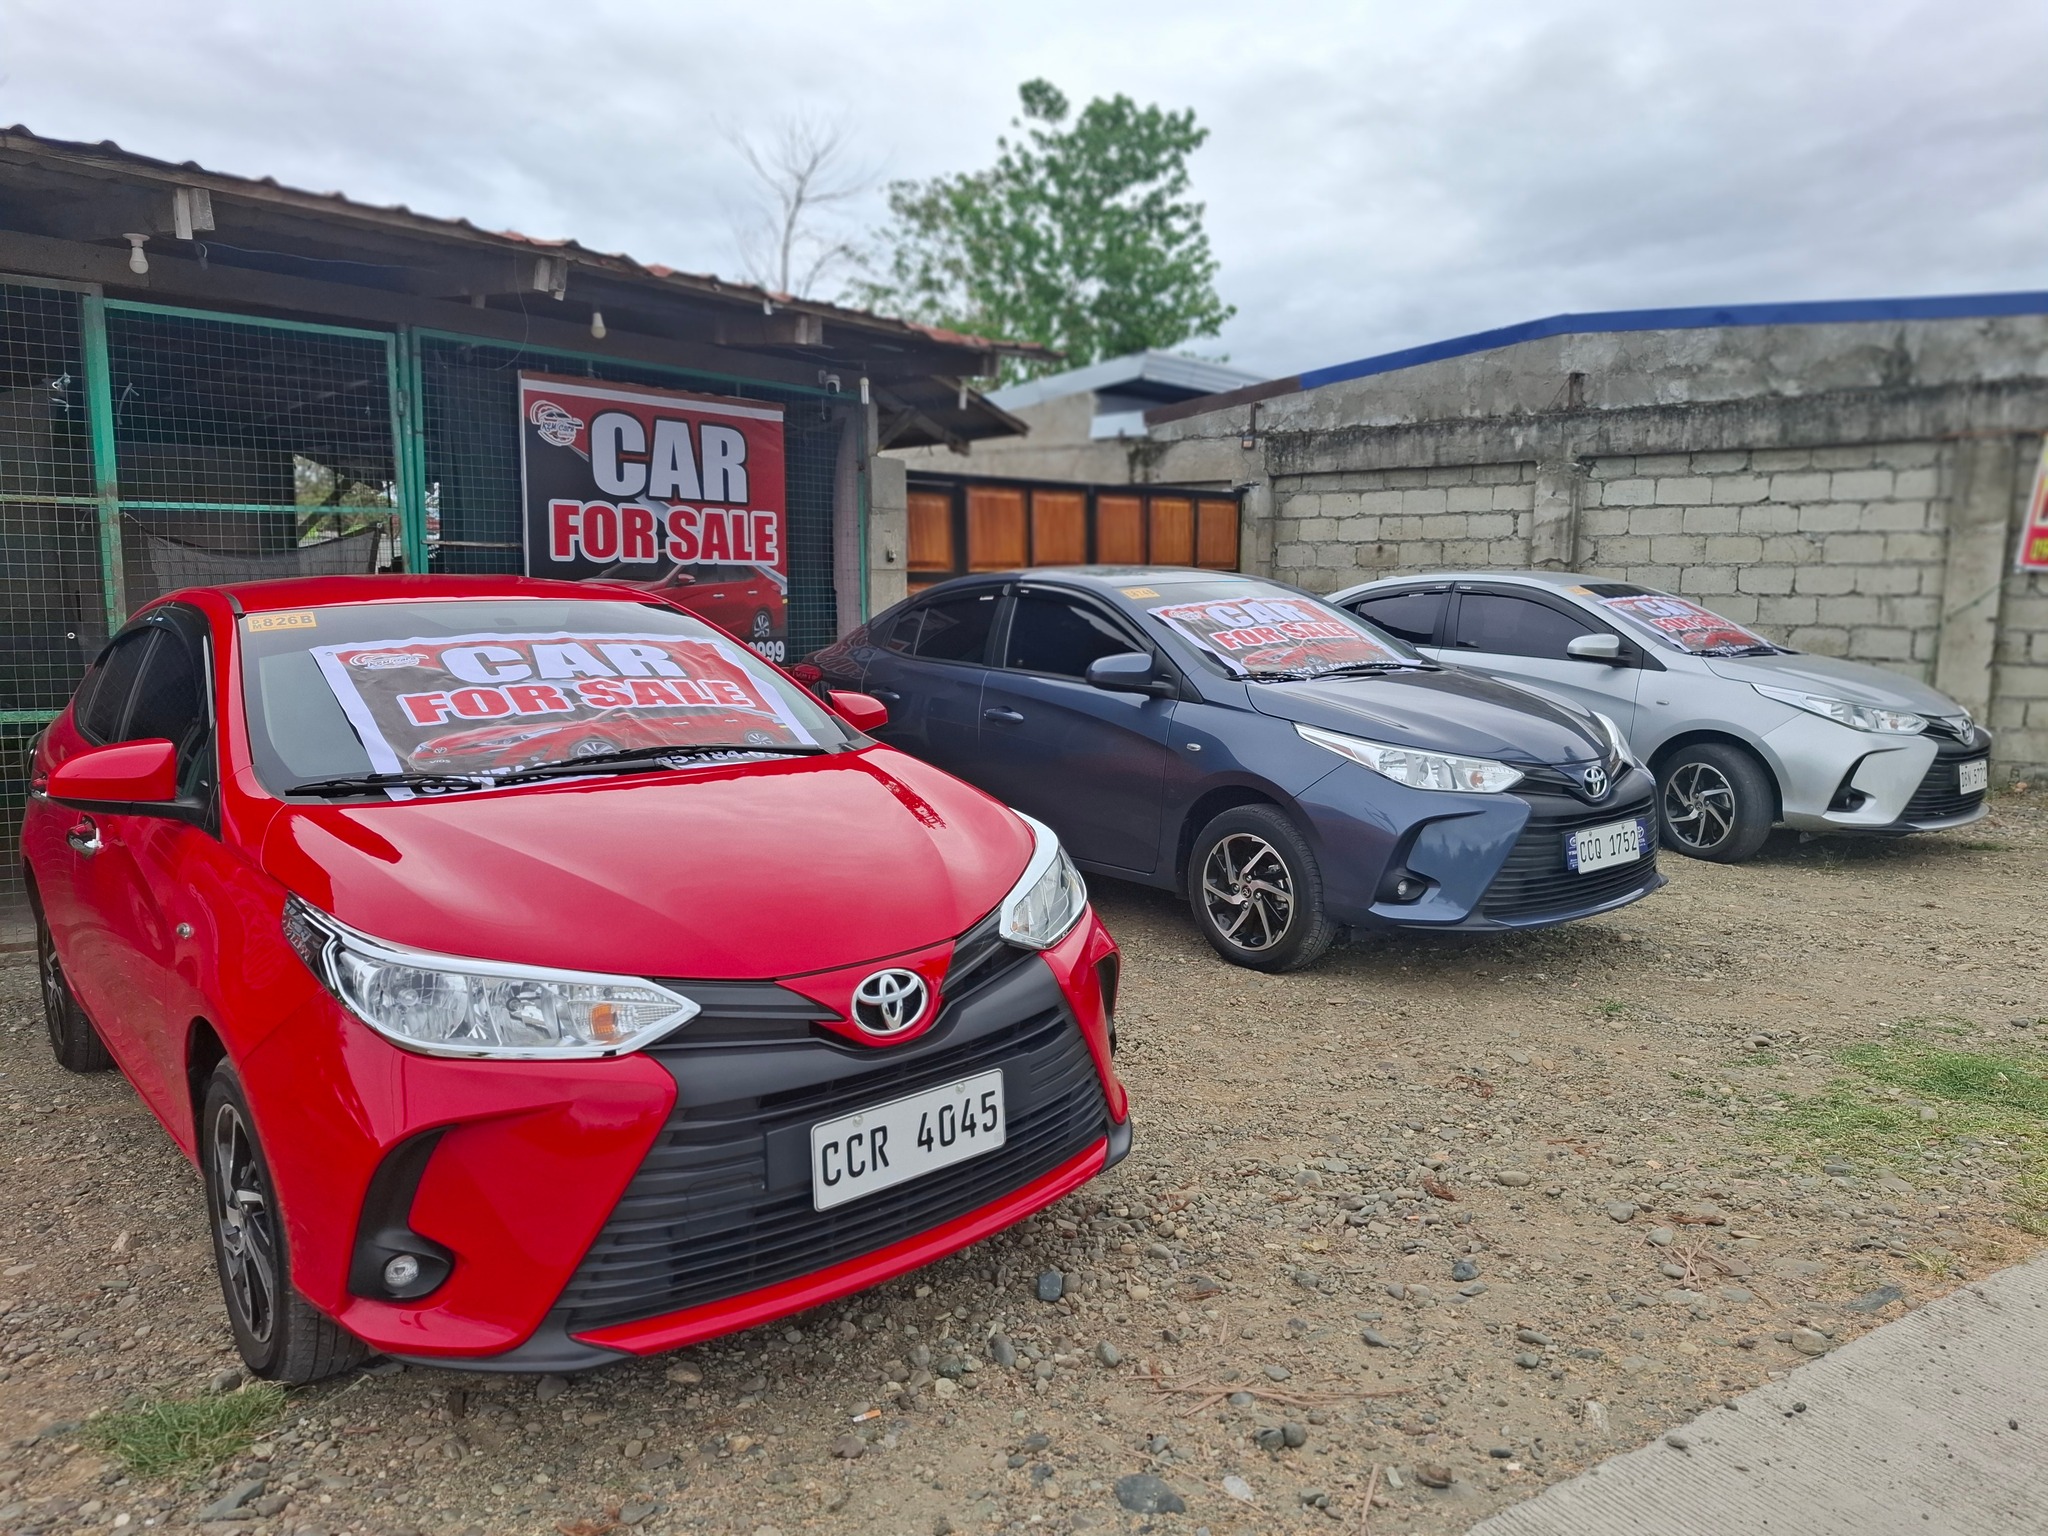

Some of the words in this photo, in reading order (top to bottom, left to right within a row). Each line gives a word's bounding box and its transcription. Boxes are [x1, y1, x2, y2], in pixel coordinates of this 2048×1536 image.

[590, 411, 748, 503] CAR
[549, 499, 658, 563] FOR
[666, 506, 778, 565] SALE
[1205, 601, 1316, 628] CAR
[1209, 626, 1290, 650] FOR
[1278, 622, 1358, 640] SALE
[441, 642, 684, 684] CAR
[396, 683, 575, 726] FOR
[573, 679, 758, 711] SALE
[1579, 838, 1602, 863] CCQ
[1609, 830, 1637, 856] 1752
[821, 1125, 890, 1187] CCR
[917, 1089, 998, 1153] 4045
